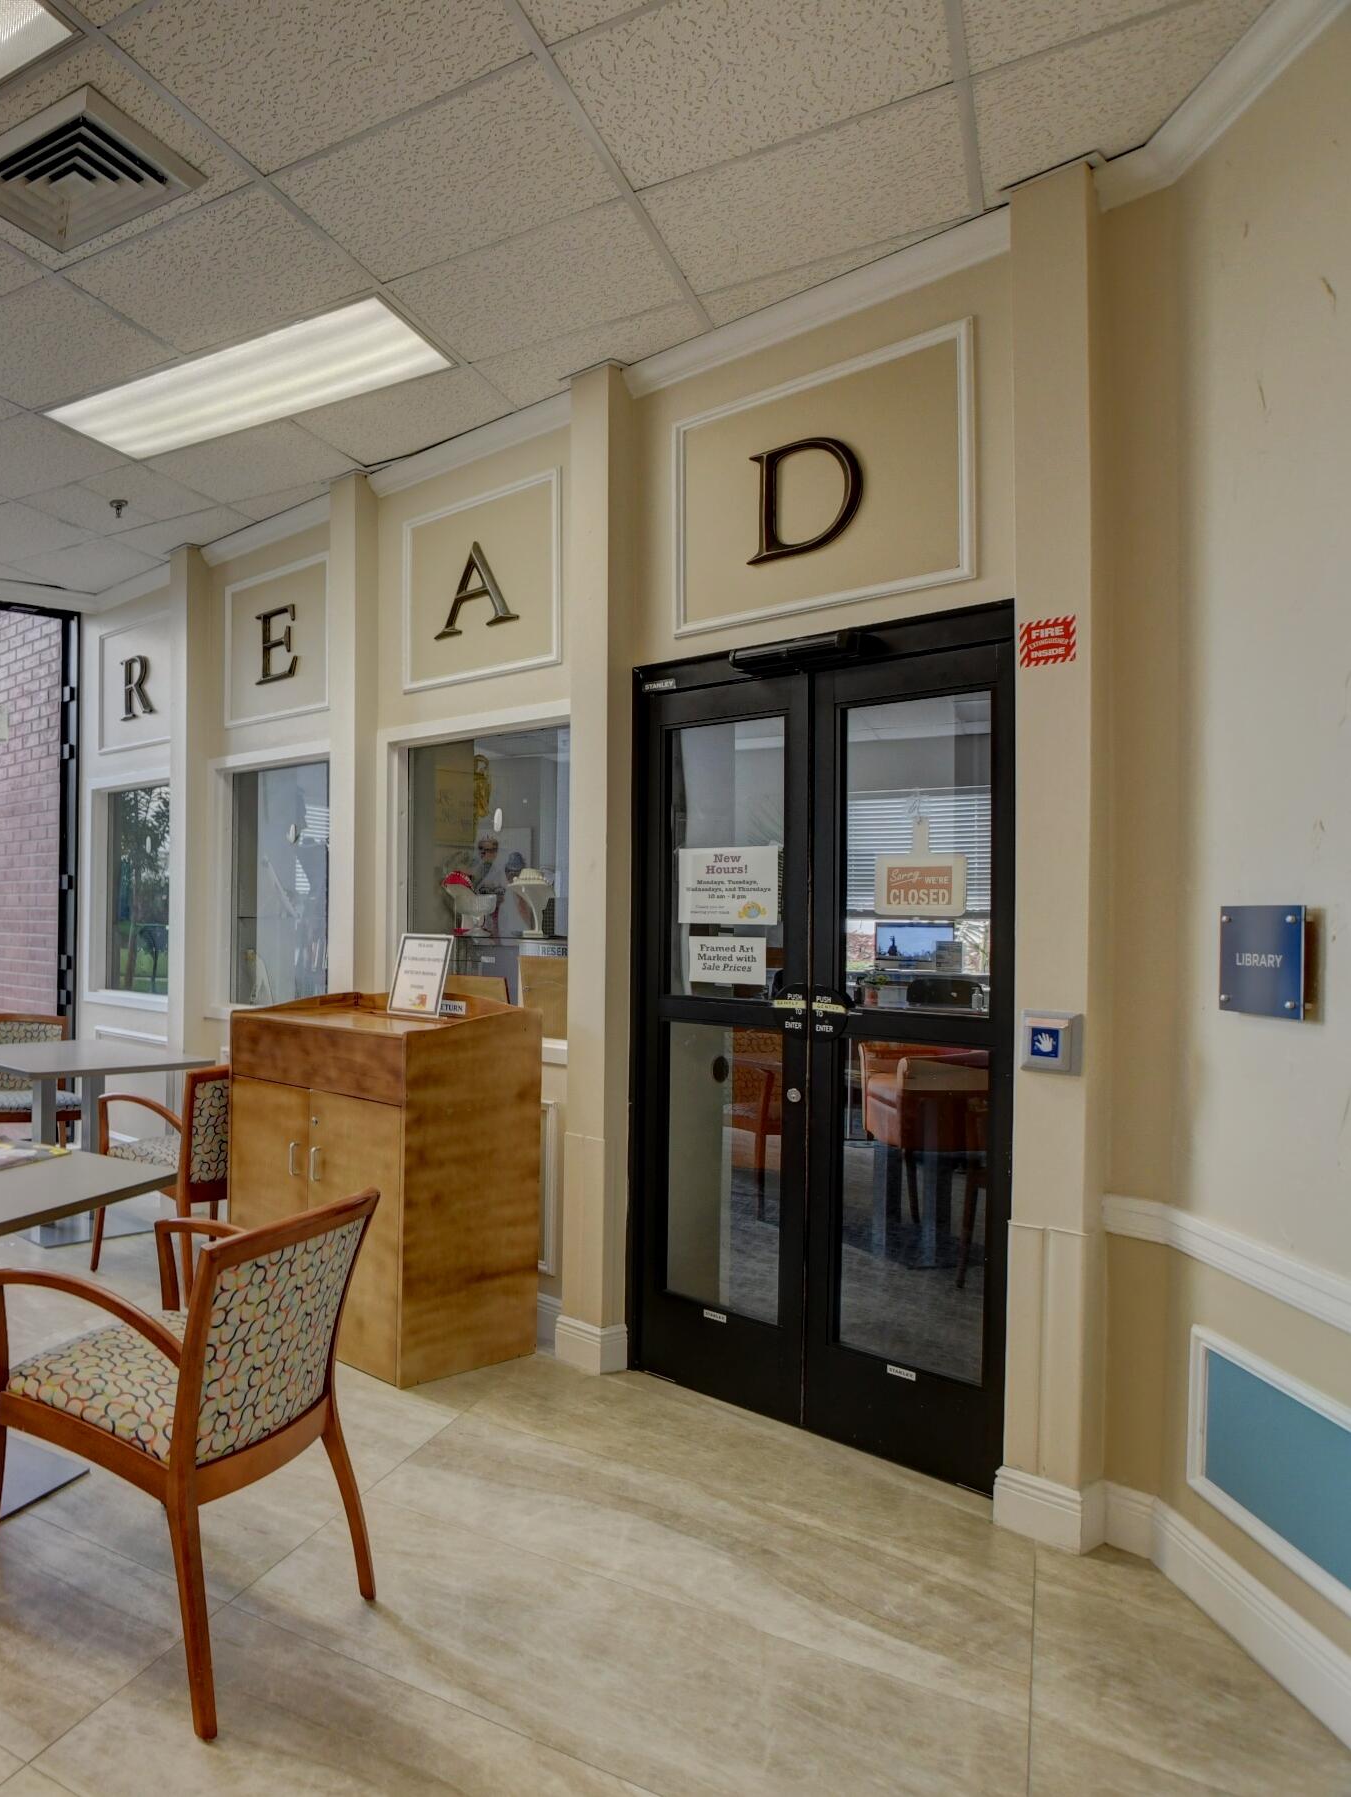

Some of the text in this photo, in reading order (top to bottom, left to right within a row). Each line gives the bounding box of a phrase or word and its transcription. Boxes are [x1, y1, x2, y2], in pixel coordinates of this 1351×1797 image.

[1031, 625, 1064, 640] FIRE
[1029, 637, 1069, 650] EXTINGUISHER
[1030, 647, 1066, 659] INSIDE
[644, 680, 674, 691] STANLEY
[713, 853, 742, 863] New
[705, 864, 749, 875] Hours!
[889, 868, 949, 886] Sorry WE'RE
[889, 888, 949, 905] CLOSED
[541, 946, 568, 956] RESER
[699, 944, 754, 953] Framed Art
[697, 953, 757, 963] Marked with
[1235, 952, 1283, 968] LIBRARY
[701, 962, 752, 972] Sale Prices
[815, 995, 832, 1003] PUSH
[440, 1003, 463, 1012] ETURN
[815, 1010, 824, 1018] TO
[784, 1021, 802, 1030] ENTER
[815, 1024, 834, 1033] ENTER
